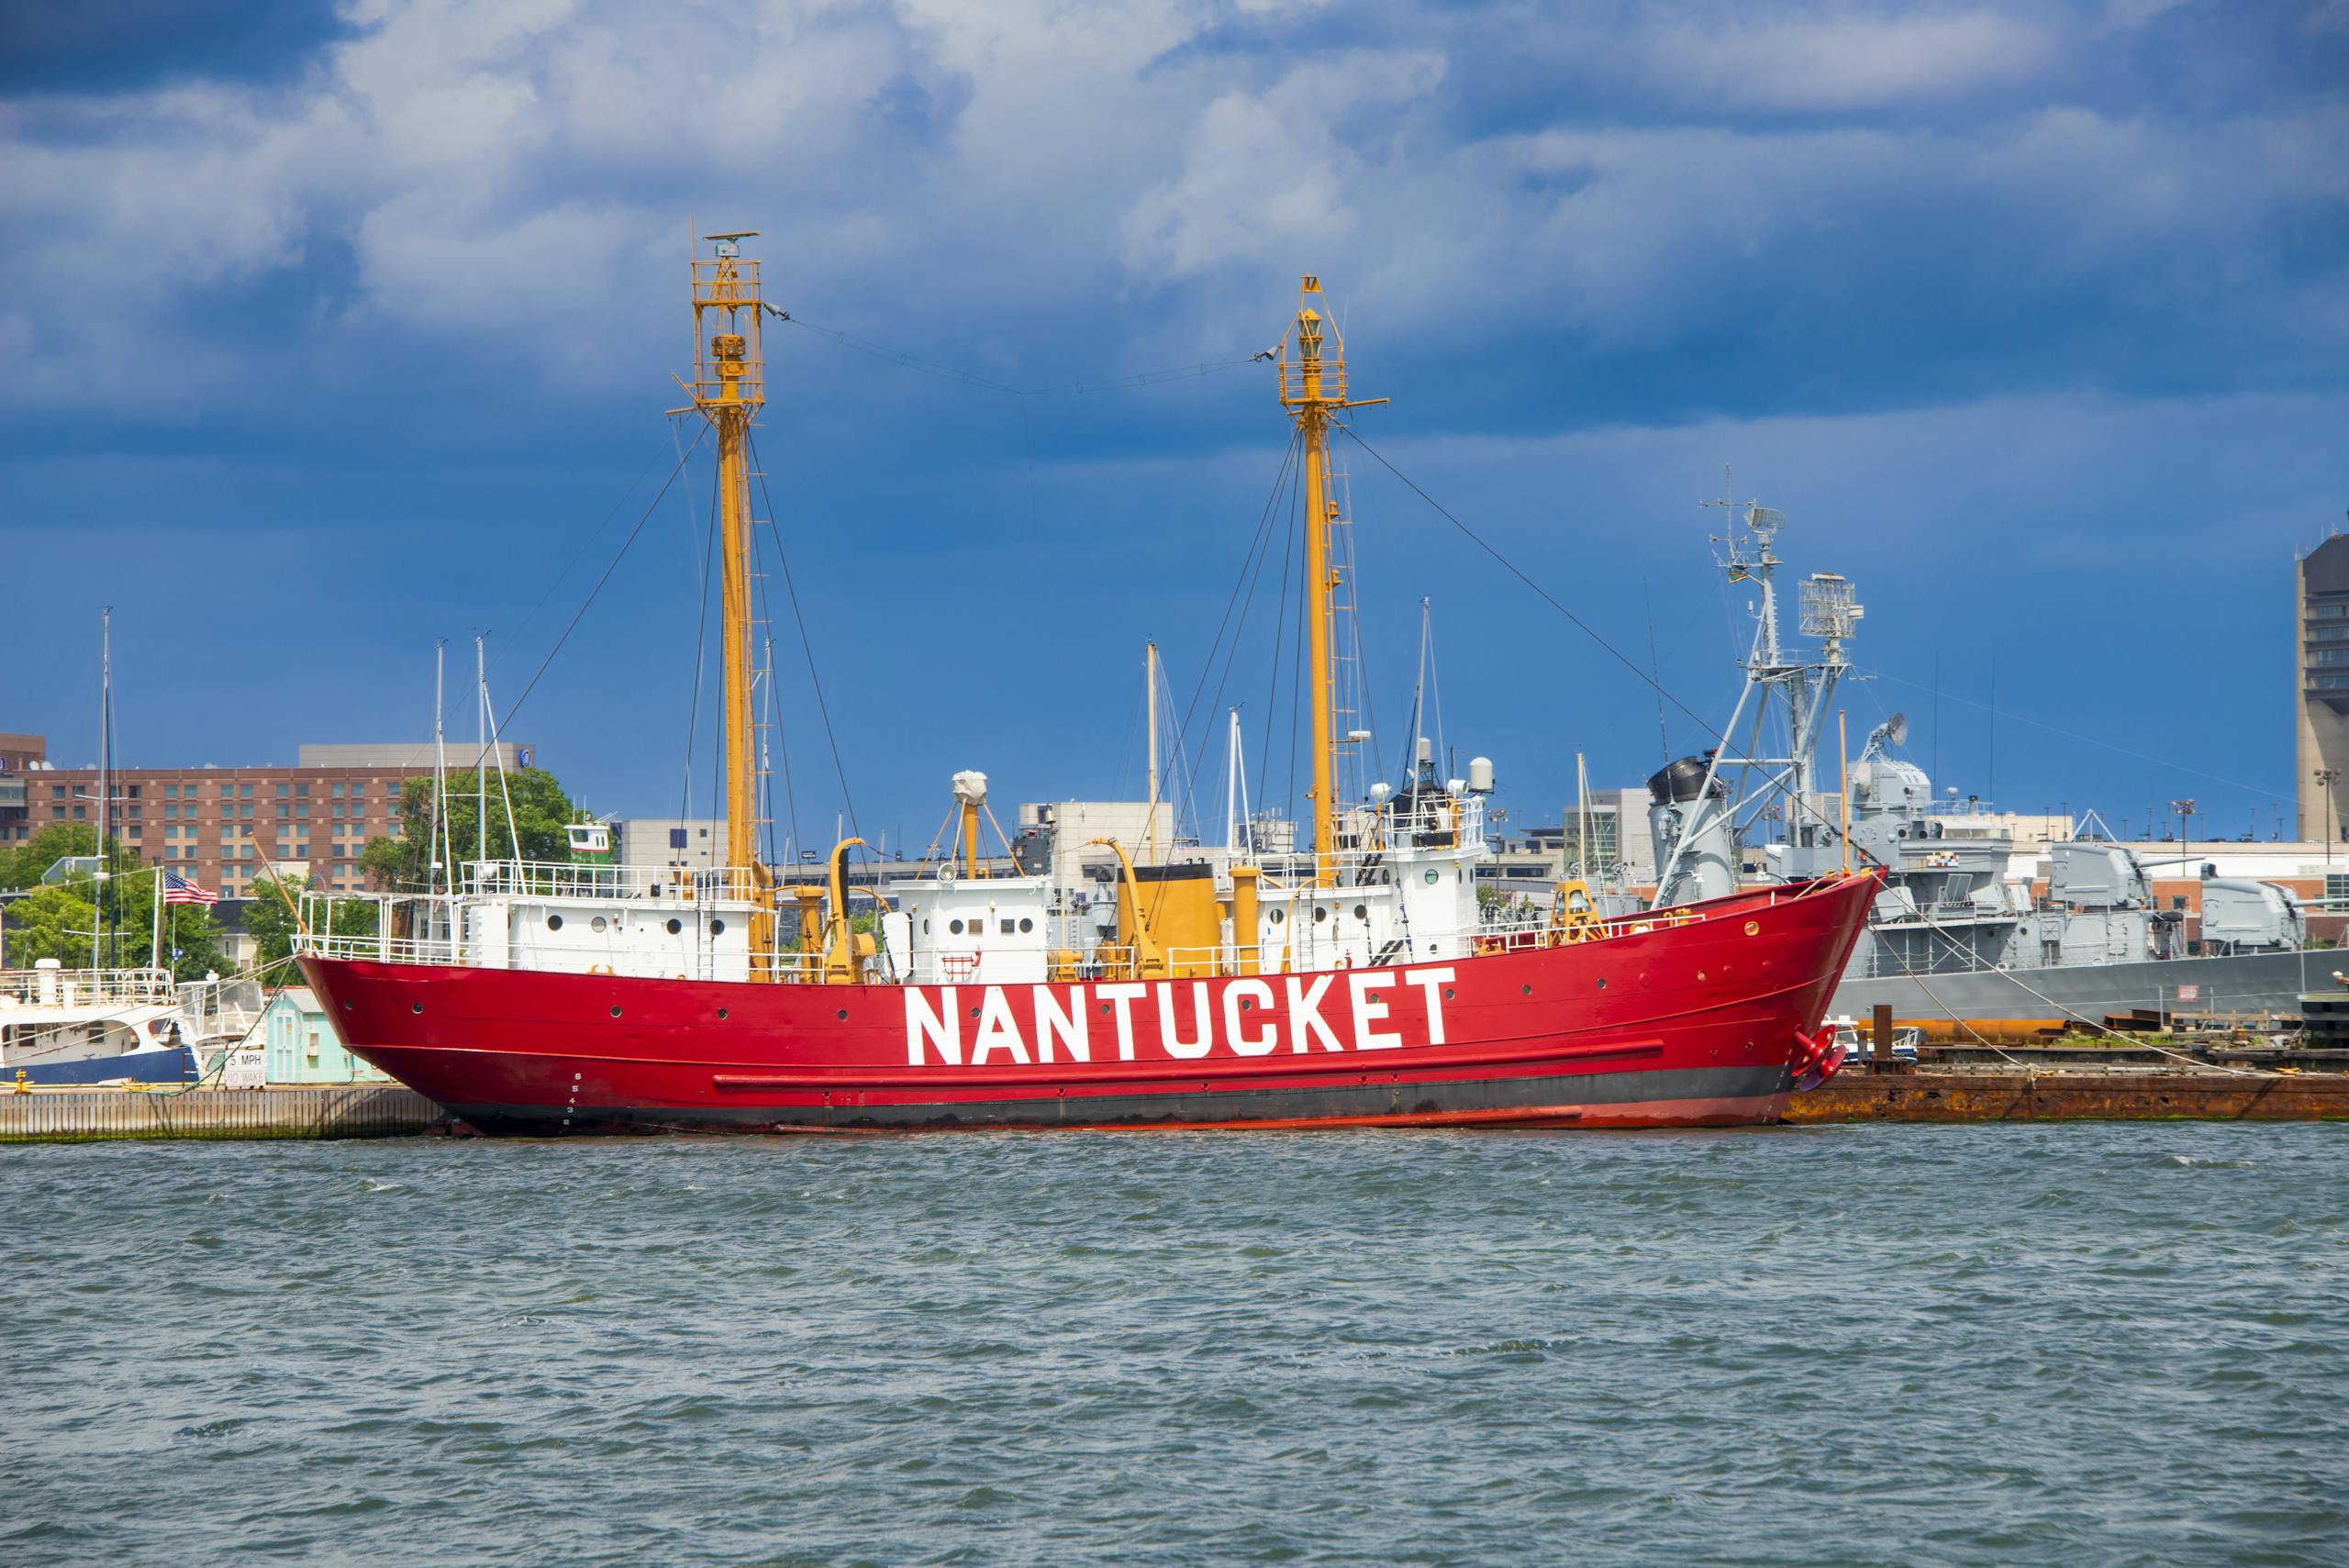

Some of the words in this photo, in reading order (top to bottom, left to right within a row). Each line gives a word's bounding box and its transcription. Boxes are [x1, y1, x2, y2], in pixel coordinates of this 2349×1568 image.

[904, 967, 1456, 1066] NANTUCKET
[229, 1055, 236, 1065] 5
[241, 1054, 261, 1064] MPH
[227, 1073, 239, 1083] NO
[242, 1073, 263, 1083] WAKE
